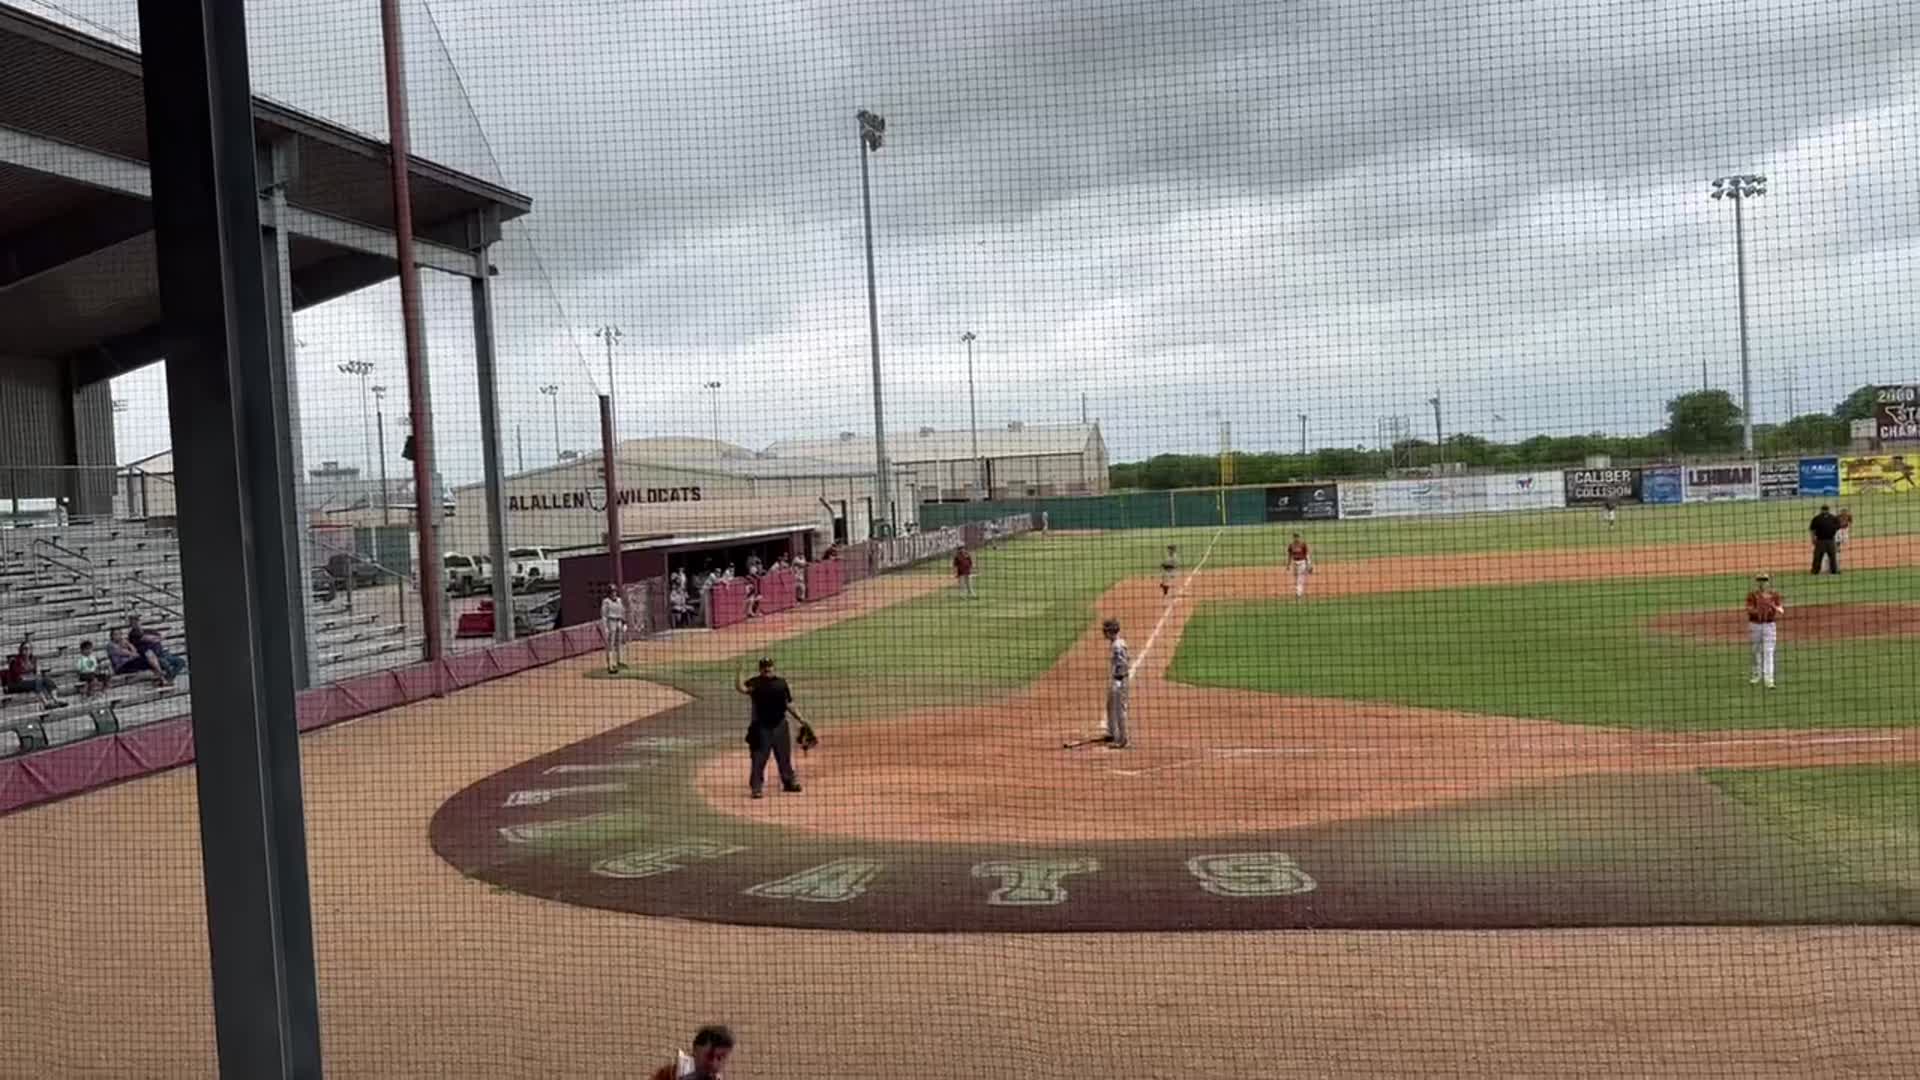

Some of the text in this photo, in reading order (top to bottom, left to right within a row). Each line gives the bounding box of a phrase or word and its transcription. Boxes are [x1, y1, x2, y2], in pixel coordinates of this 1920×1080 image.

[1880, 424, 1920, 439] CHAM
[1574, 470, 1632, 484] CALIBER
[1575, 484, 1633, 498] COLLISION
[508, 486, 701, 511] ALALLEN WILDCATS
